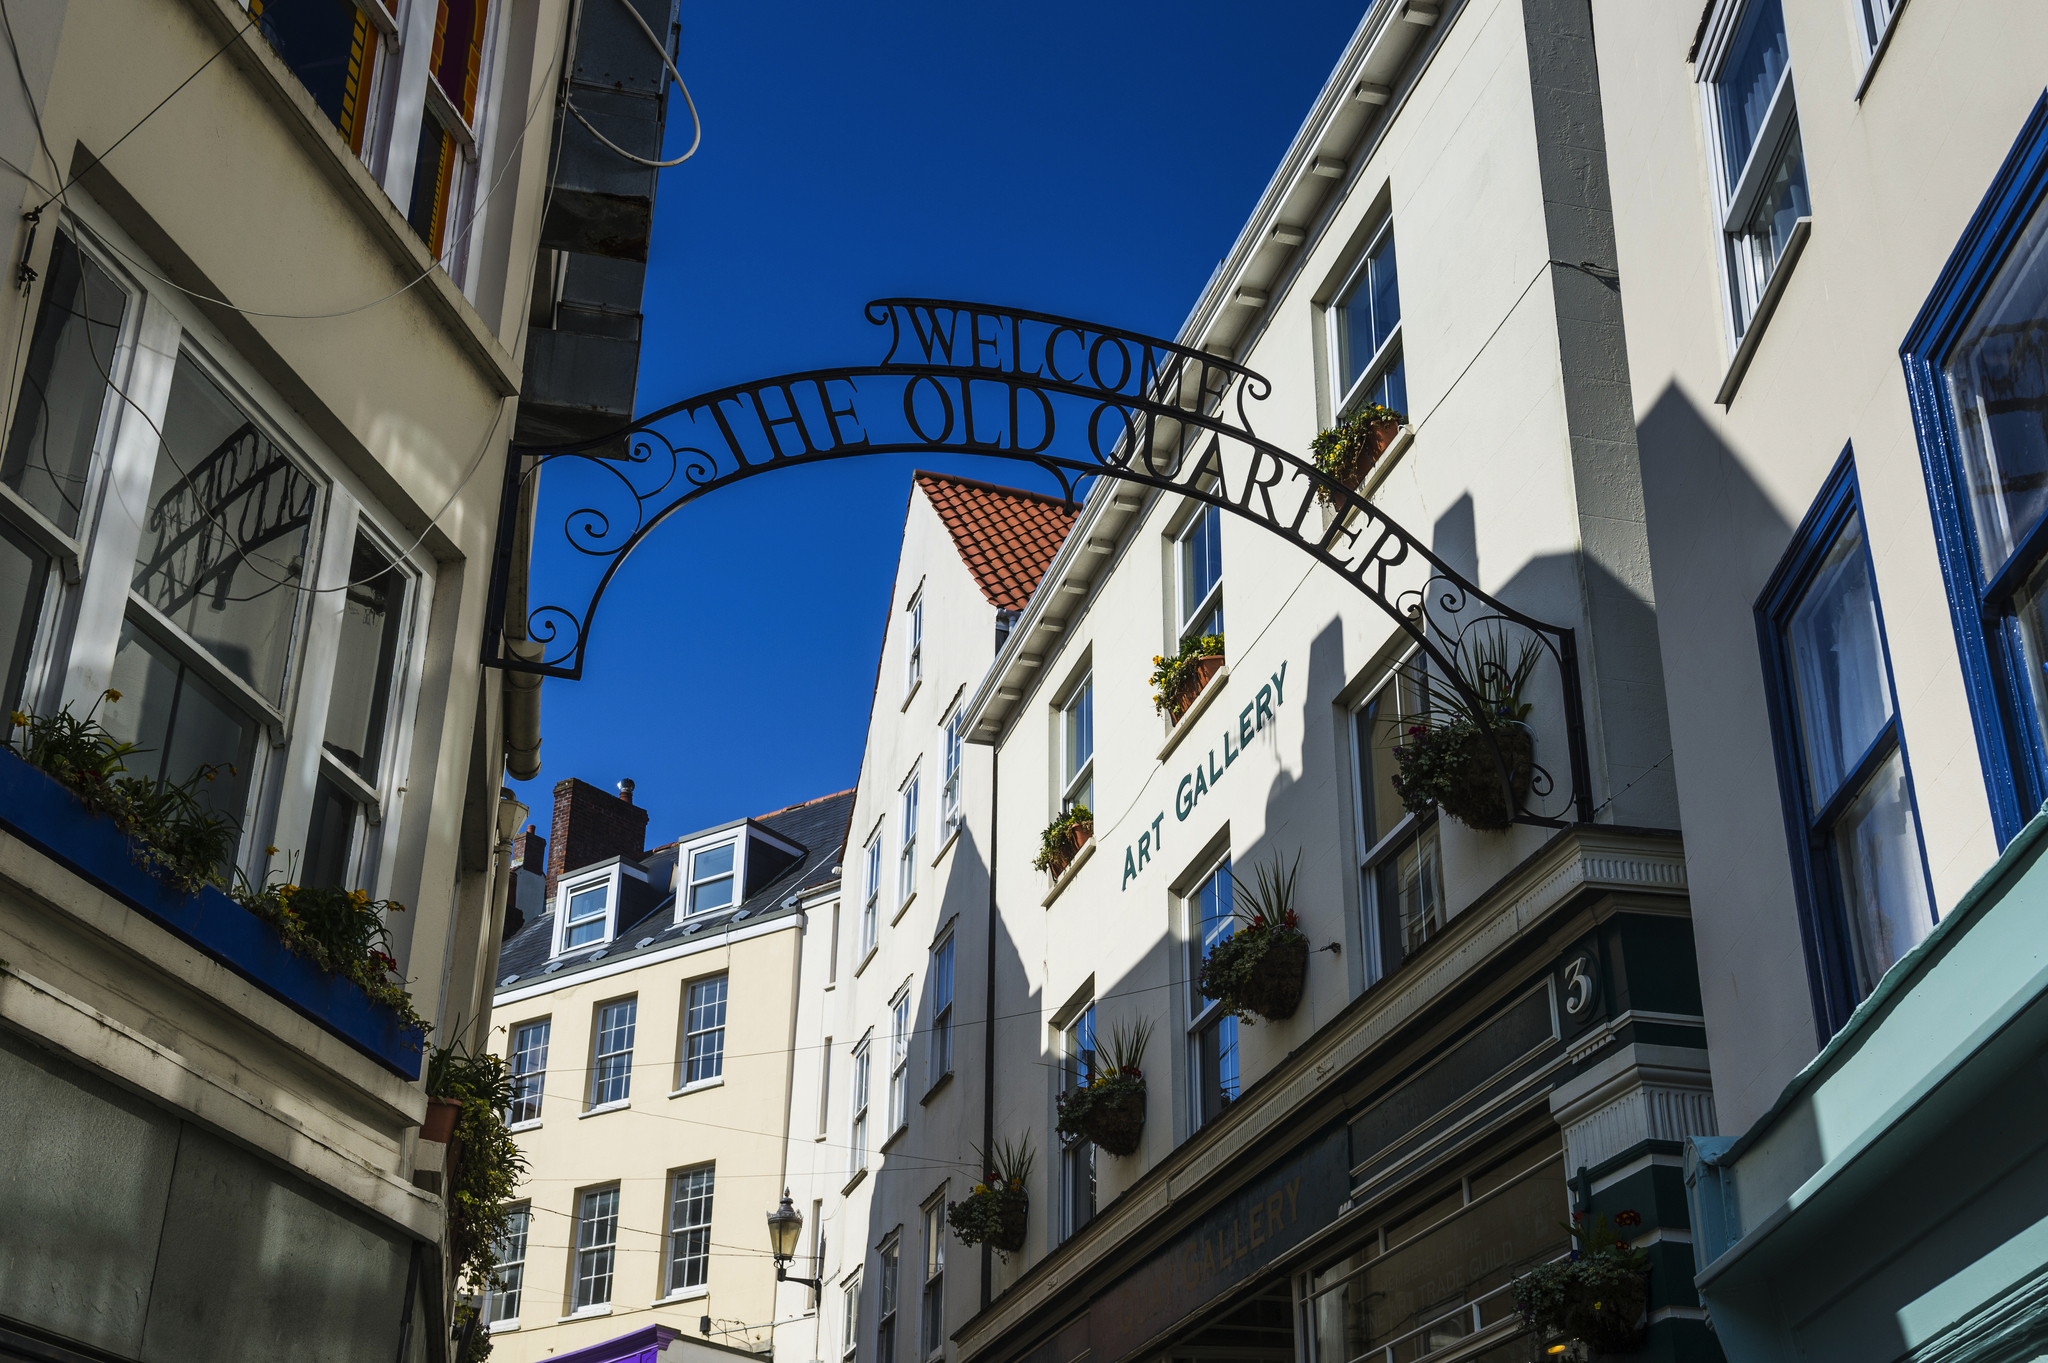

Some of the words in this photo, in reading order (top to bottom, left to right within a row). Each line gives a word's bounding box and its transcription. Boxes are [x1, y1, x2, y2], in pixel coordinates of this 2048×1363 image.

[905, 305, 1231, 423] WELCOME
[686, 375, 870, 474] THE
[903, 374, 1055, 454] OLD
[1088, 401, 1408, 599] QUARTER
[1121, 811, 1164, 892] ART
[1175, 660, 1288, 822] GALLERY
[1564, 957, 1592, 1014] 3
[1118, 1265, 1173, 1340] QUAY
[1182, 1176, 1302, 1291] GALLERY
[1390, 1292, 1413, 1319] ART
[1418, 1265, 1465, 1306] TRADE
[1469, 1241, 1513, 1279] GUILD
[1436, 1244, 1453, 1264] OF
[1458, 1228, 1482, 1255] THE
